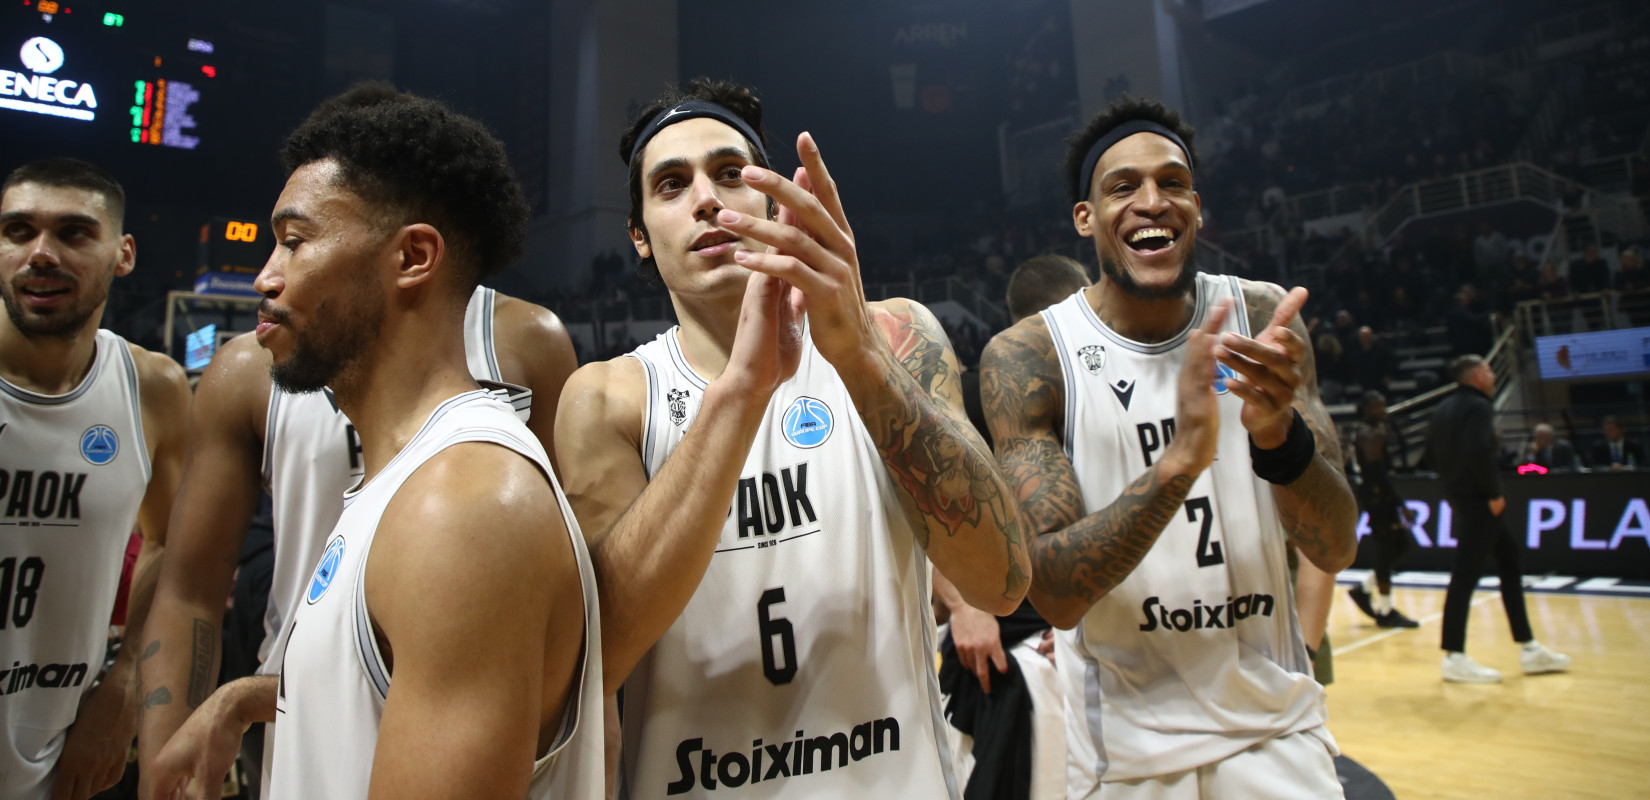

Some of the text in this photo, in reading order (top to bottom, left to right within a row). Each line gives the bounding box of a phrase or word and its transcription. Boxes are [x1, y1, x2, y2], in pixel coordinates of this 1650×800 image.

[0, 69, 97, 108] ENECA
[225, 221, 258, 242] 00
[728, 463, 817, 538] AOK
[1184, 496, 1224, 568] 2
[0, 556, 45, 630] 18
[757, 586, 798, 686] 6
[667, 716, 900, 796] Stoiximan
